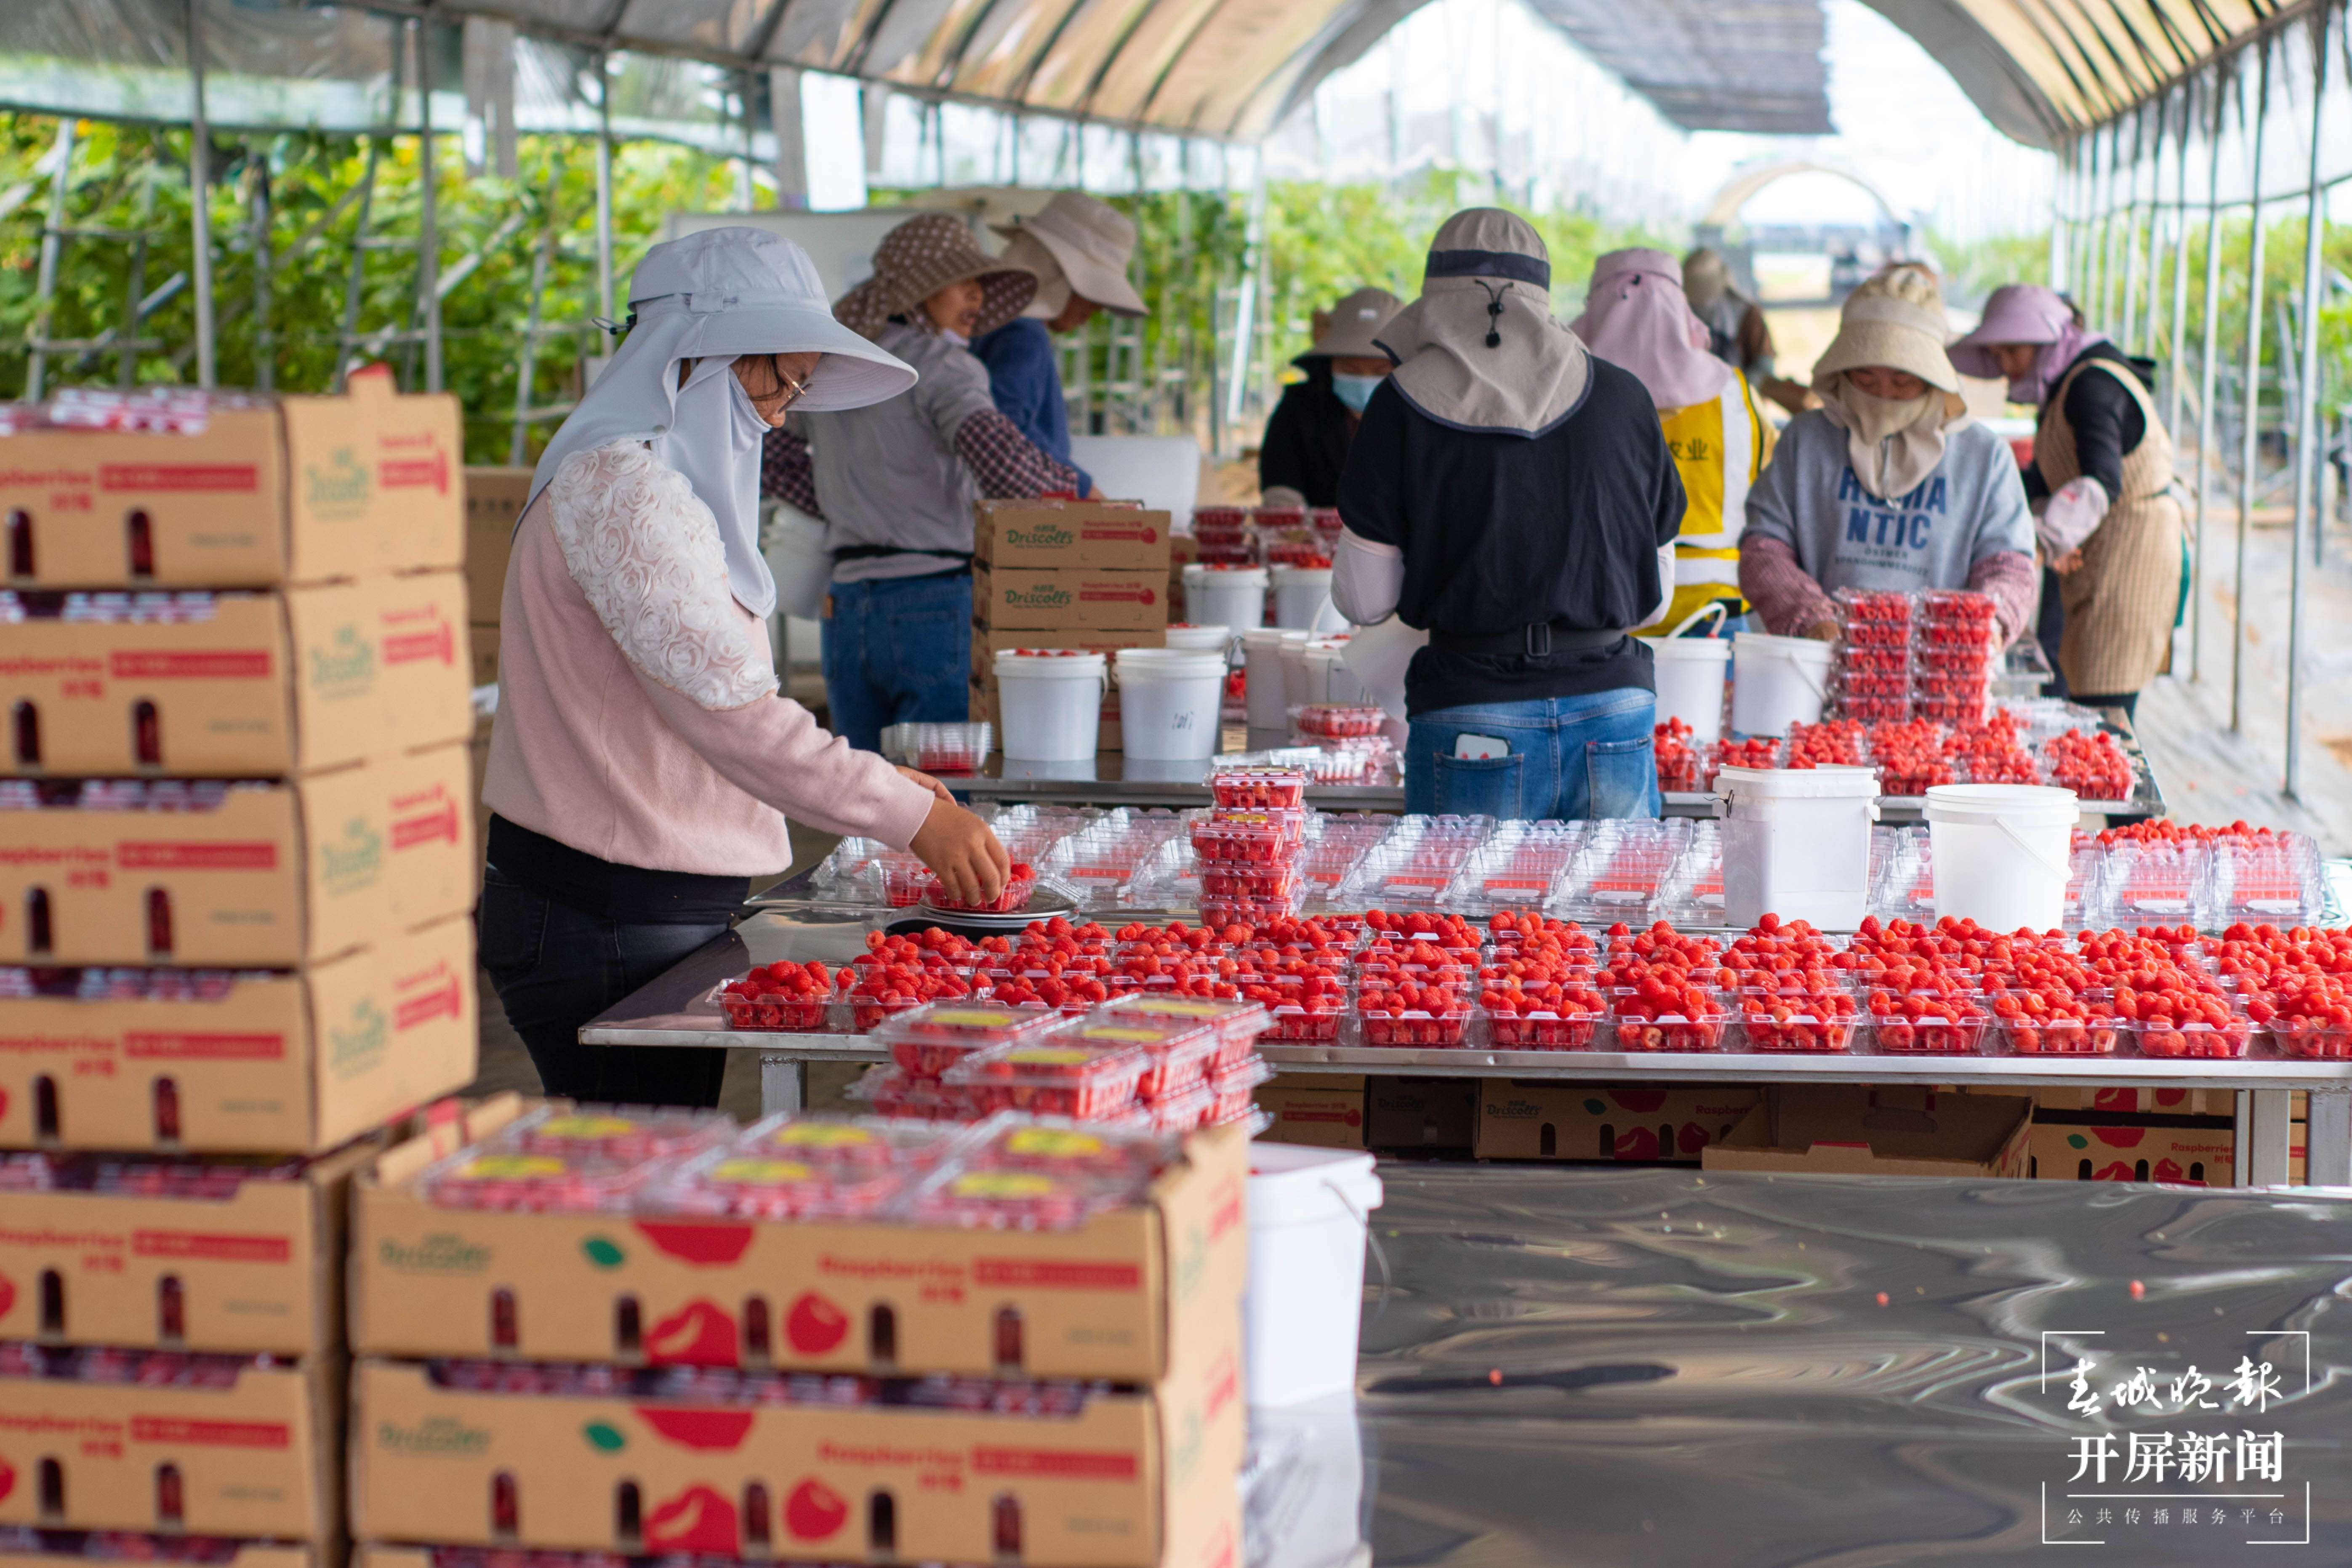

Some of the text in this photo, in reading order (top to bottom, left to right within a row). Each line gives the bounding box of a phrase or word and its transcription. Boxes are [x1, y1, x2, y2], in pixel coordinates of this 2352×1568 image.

[1838, 466, 1947, 515] RMA
[1846, 506, 1931, 550] NTIC
[1006, 529, 1073, 544] Driscoll's
[1005, 590, 1073, 604] Driscoll's
[1486, 1103, 1542, 1115] Driscoll's
